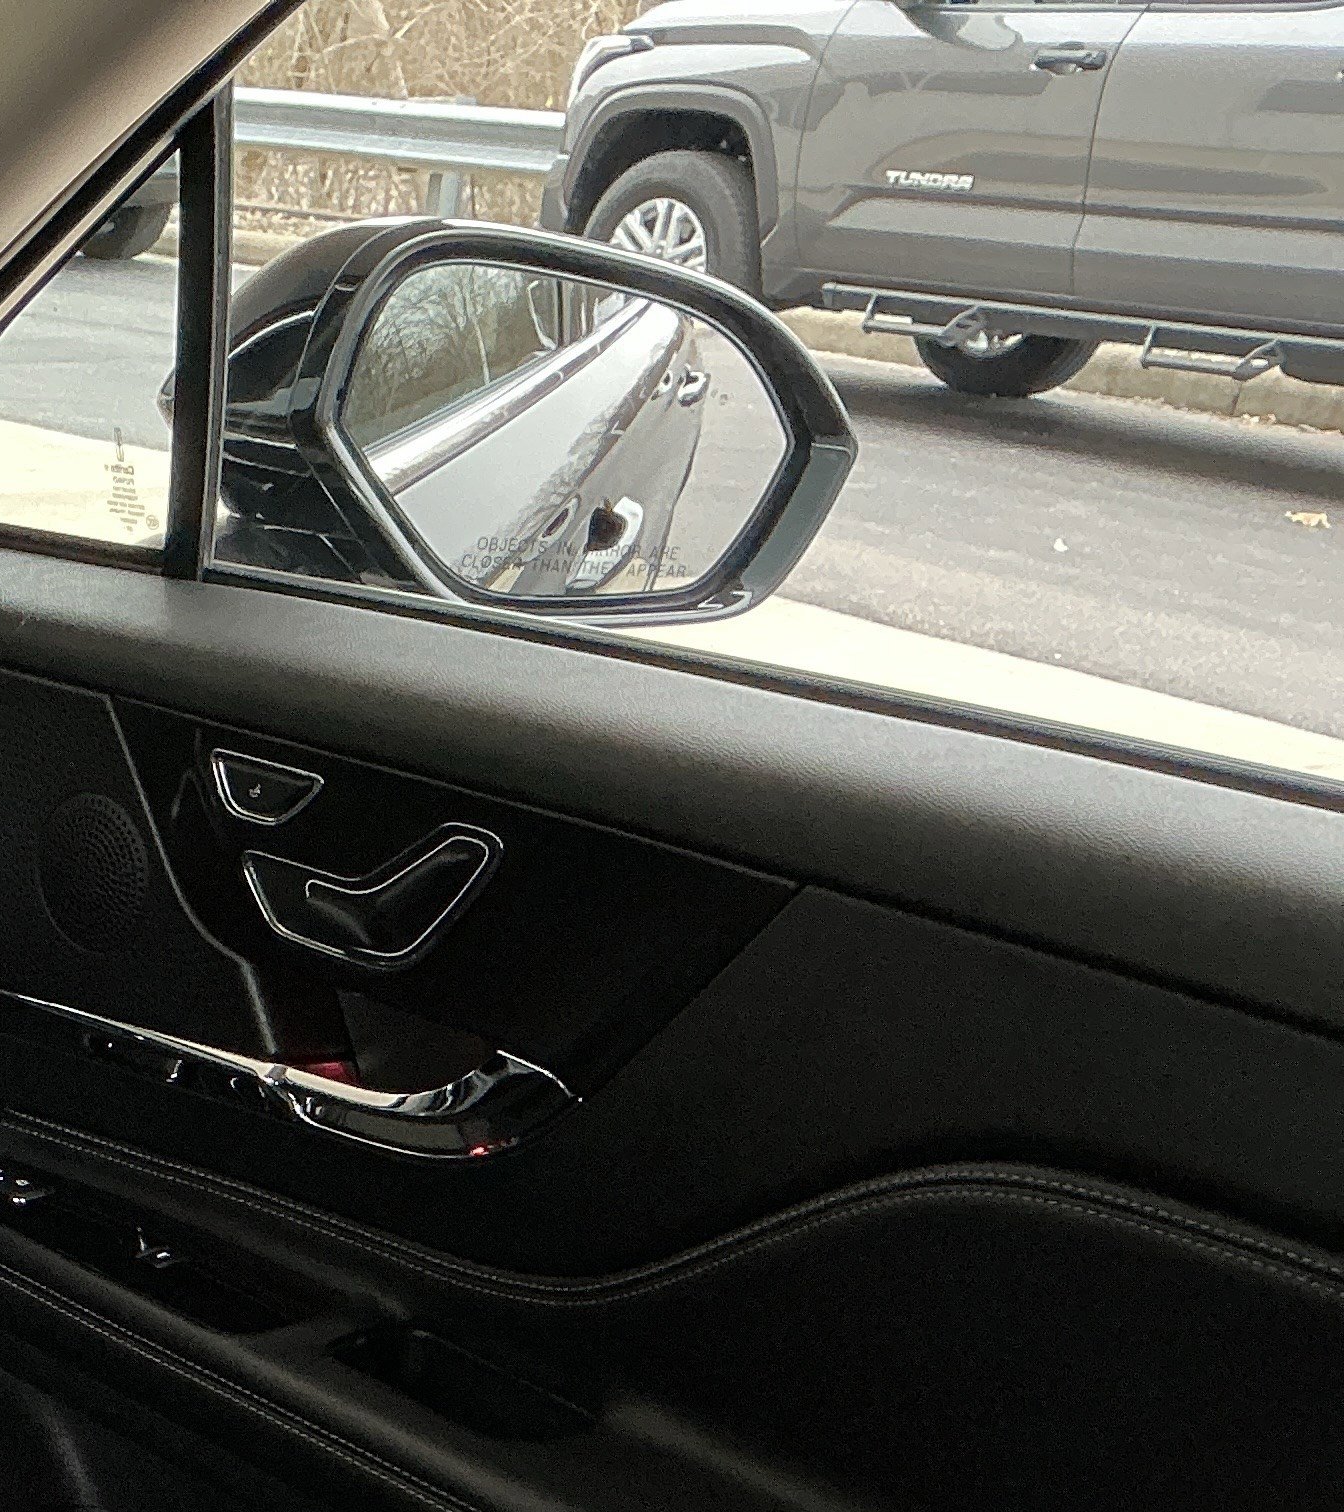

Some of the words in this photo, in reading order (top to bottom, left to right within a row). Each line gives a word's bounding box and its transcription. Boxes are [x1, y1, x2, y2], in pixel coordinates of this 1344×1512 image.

[885, 169, 975, 191] TUNDRA
[477, 536, 547, 554] OBJECTS
[461, 554, 523, 571] CLOSER
[531, 558, 573, 574] THAN
[626, 562, 688, 578] APPEAR
